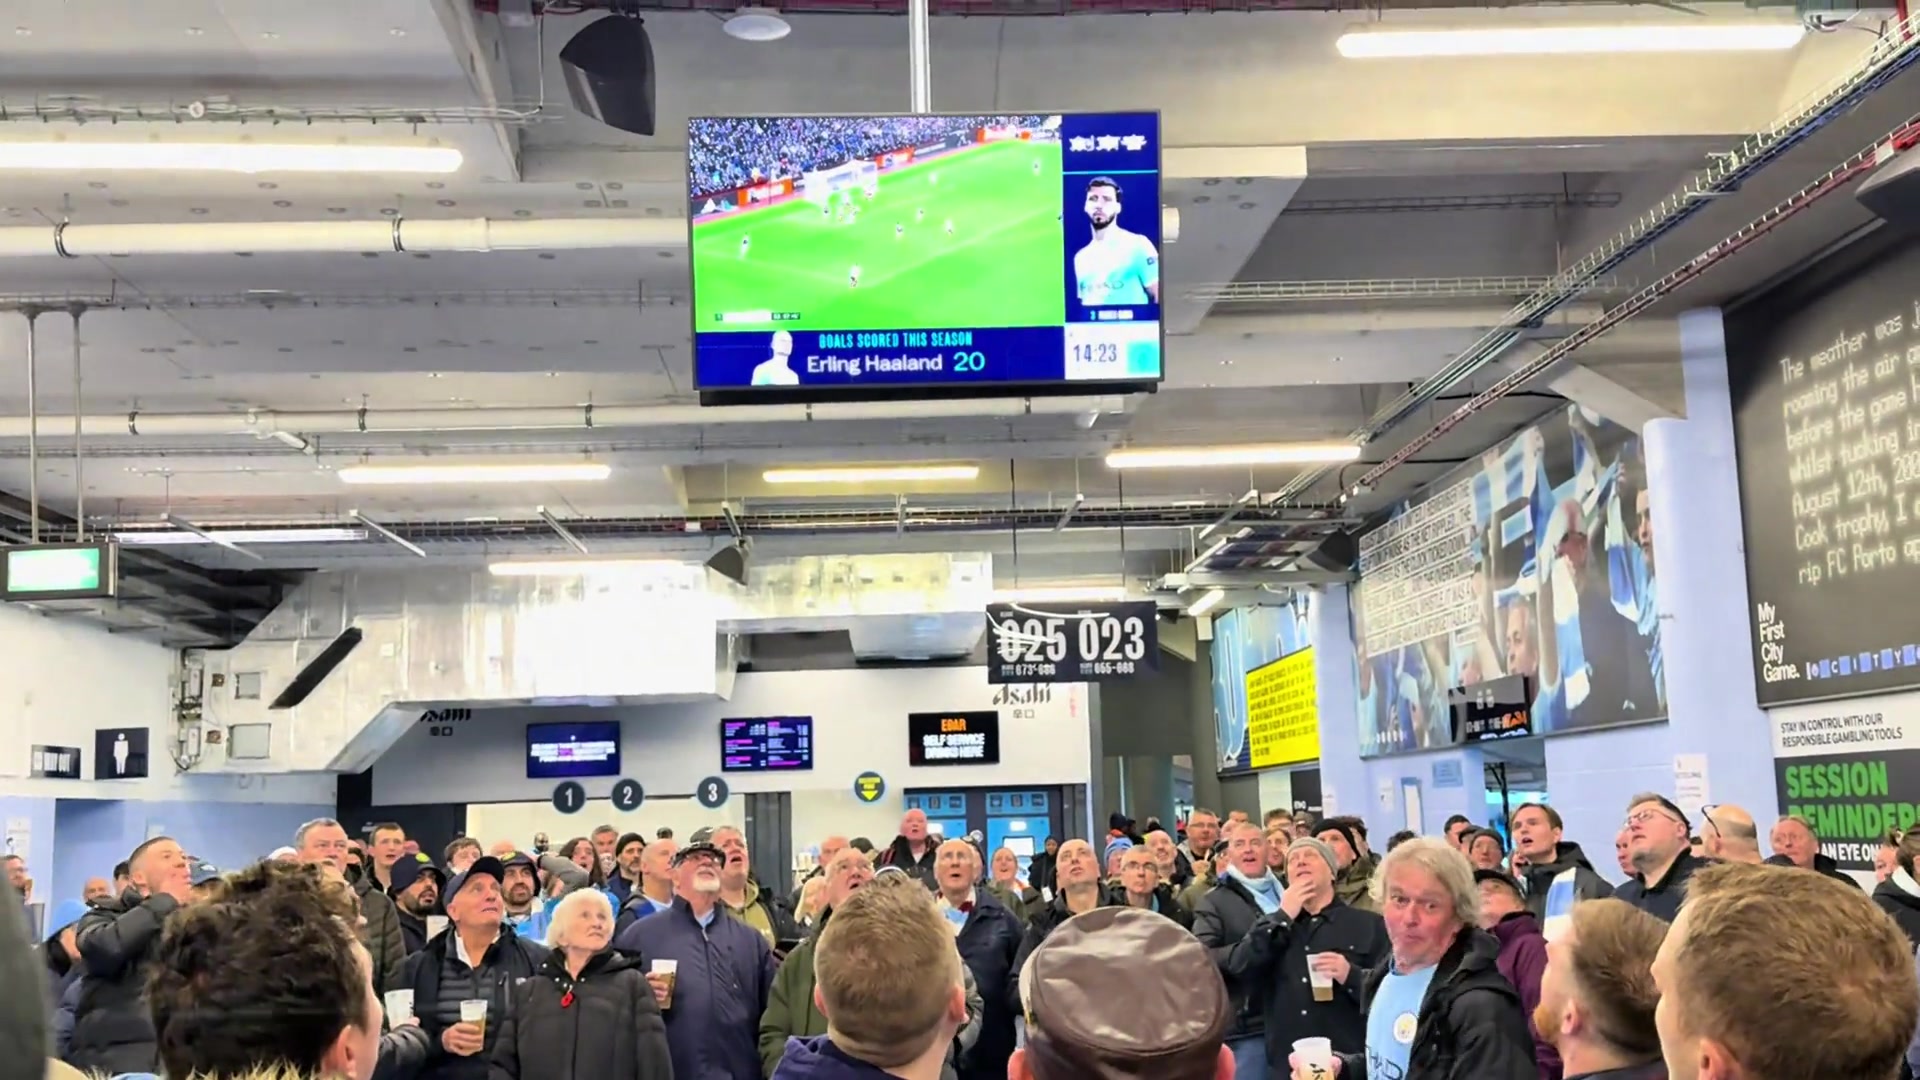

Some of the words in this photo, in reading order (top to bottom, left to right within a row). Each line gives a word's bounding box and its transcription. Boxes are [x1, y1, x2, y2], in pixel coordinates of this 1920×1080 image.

[819, 333, 853, 349] GOALS
[857, 332, 899, 349] SCORED
[903, 332, 928, 348] THIS
[931, 331, 972, 347] SEASON
[1780, 357, 1805, 384] The
[1810, 331, 1868, 370] weather
[1875, 314, 1903, 339] was
[807, 355, 861, 376] Erling
[865, 354, 943, 372] Haaland
[953, 351, 986, 372] 20
[1073, 343, 1117, 362] 14:23
[1783, 381, 1838, 419] roaming
[1841, 361, 1869, 392] the
[1874, 353, 1900, 379] air
[1785, 416, 1834, 452] before
[1838, 400, 1866, 432] the
[1870, 391, 1907, 425] game
[1789, 446, 1832, 485] whilst
[1840, 427, 1898, 468] tucking
[1792, 480, 1840, 520] August
[1847, 462, 1888, 500] 12th,
[1795, 517, 1829, 552] Cook
[1834, 500, 1890, 541] trophy,
[1894, 491, 1908, 525] I
[1799, 560, 1822, 586] rip
[1826, 547, 1848, 579] FC
[1852, 540, 1897, 572] Porto
[1757, 602, 1776, 624] My
[999, 617, 1067, 663] 025
[1078, 616, 1145, 661] 023
[1759, 620, 1785, 642] First
[1761, 642, 1784, 665] City
[1763, 662, 1801, 683] Game.
[992, 682, 1051, 705] Asahi
[1781, 722, 1797, 734] STAY
[1800, 720, 1807, 731] IN
[1807, 717, 1842, 730] CONTROL
[1844, 715, 1864, 727] WITH
[1865, 712, 1883, 725] OUR
[1782, 733, 1832, 748] RESPONSIBLE
[1833, 728, 1874, 744] GAMBLING
[1875, 727, 1903, 741] TOOLS
[1785, 761, 1888, 799] SESSION
[565, 787, 573, 807] 1
[622, 785, 632, 805] 2
[708, 783, 718, 802] 3
[1788, 802, 1920, 839] EMINDER
[1821, 843, 1837, 861] AN
[1838, 843, 1861, 861] EYE
